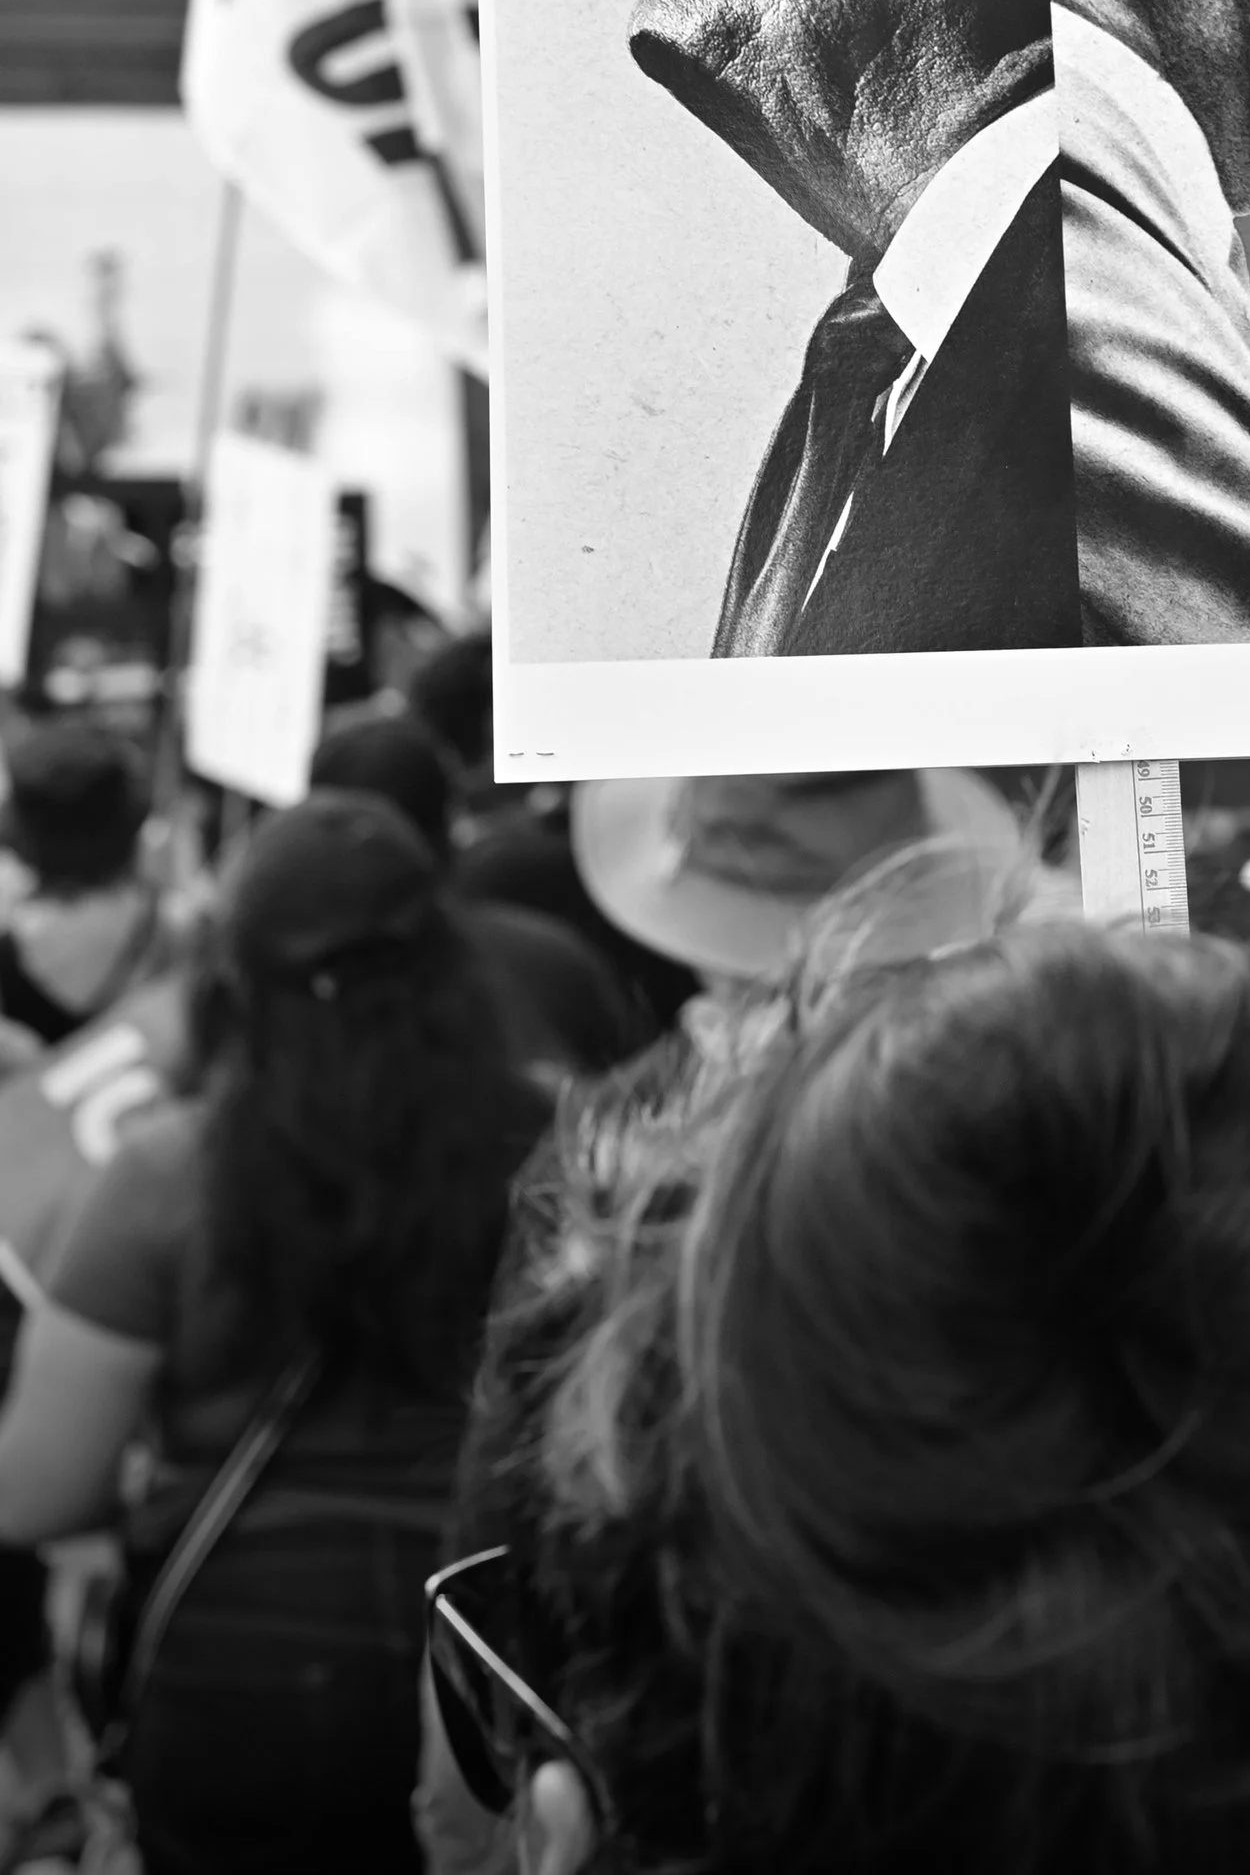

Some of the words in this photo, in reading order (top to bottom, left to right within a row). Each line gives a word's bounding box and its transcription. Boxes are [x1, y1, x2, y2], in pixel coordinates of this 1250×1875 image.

[1139, 796, 1152, 814] 50
[1142, 832, 1155, 849] 51
[1145, 869, 1158, 887] 52
